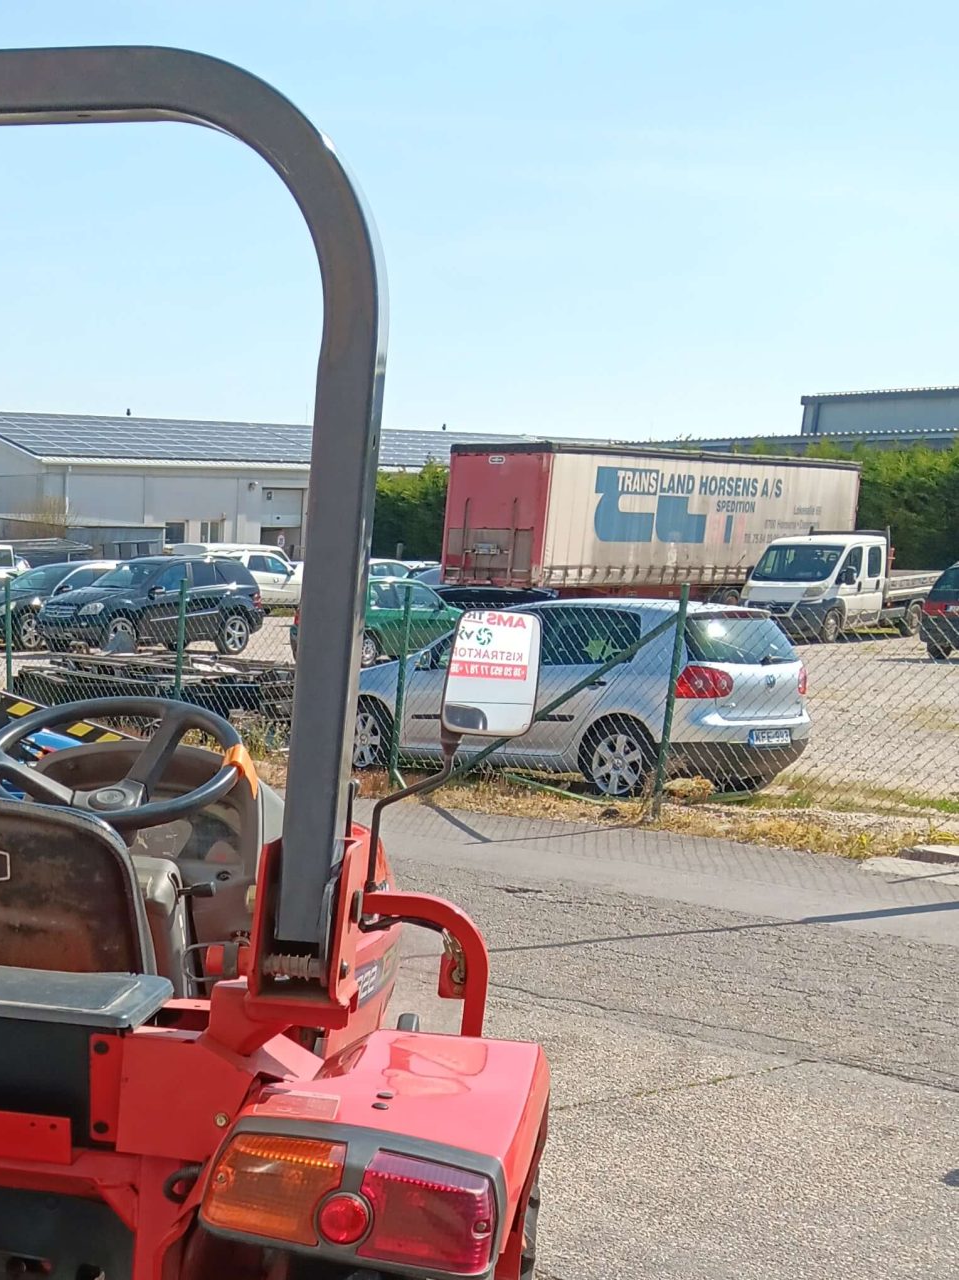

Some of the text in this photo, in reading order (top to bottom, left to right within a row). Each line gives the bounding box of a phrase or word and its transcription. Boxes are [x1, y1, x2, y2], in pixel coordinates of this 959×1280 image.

[698, 475, 758, 498] HORSENS
[761, 477, 783, 499] A/S
[716, 500, 756, 513] SPEDITION
